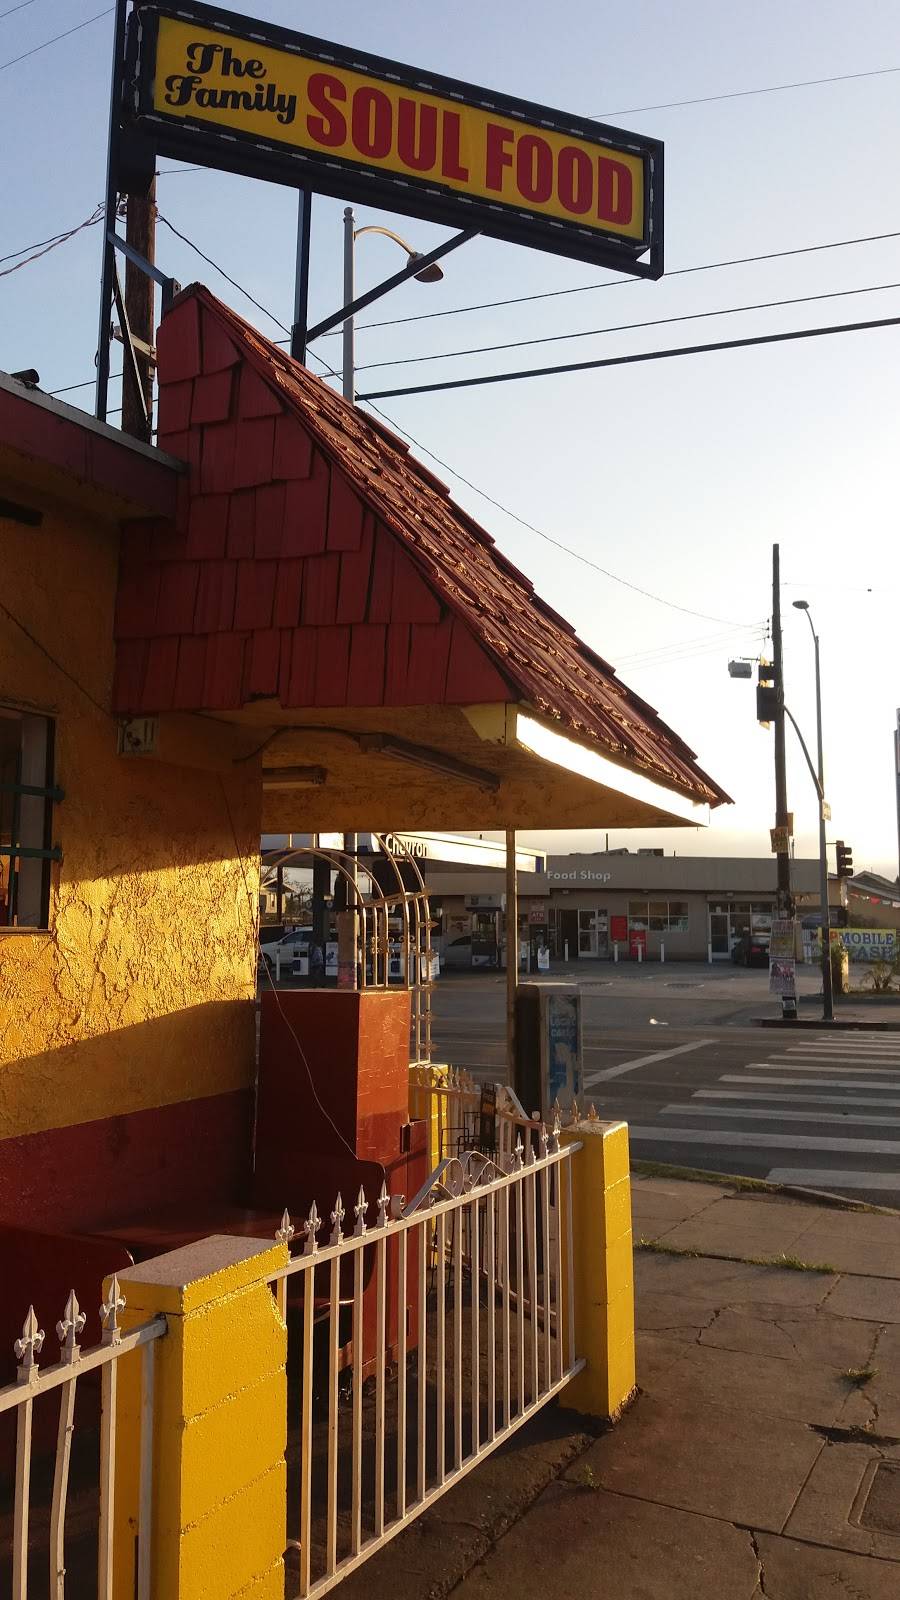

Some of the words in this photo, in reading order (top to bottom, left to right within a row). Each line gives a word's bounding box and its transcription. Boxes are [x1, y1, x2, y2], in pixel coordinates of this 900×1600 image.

[186, 42, 266, 79] The
[164, 75, 296, 125] Family
[306, 72, 469, 183] SOUL
[485, 123, 633, 226] FOOD
[385, 833, 429, 857] Chevron
[547, 870, 577, 880] Food
[580, 870, 611, 883] Shop
[842, 932, 894, 945] MOBILE
